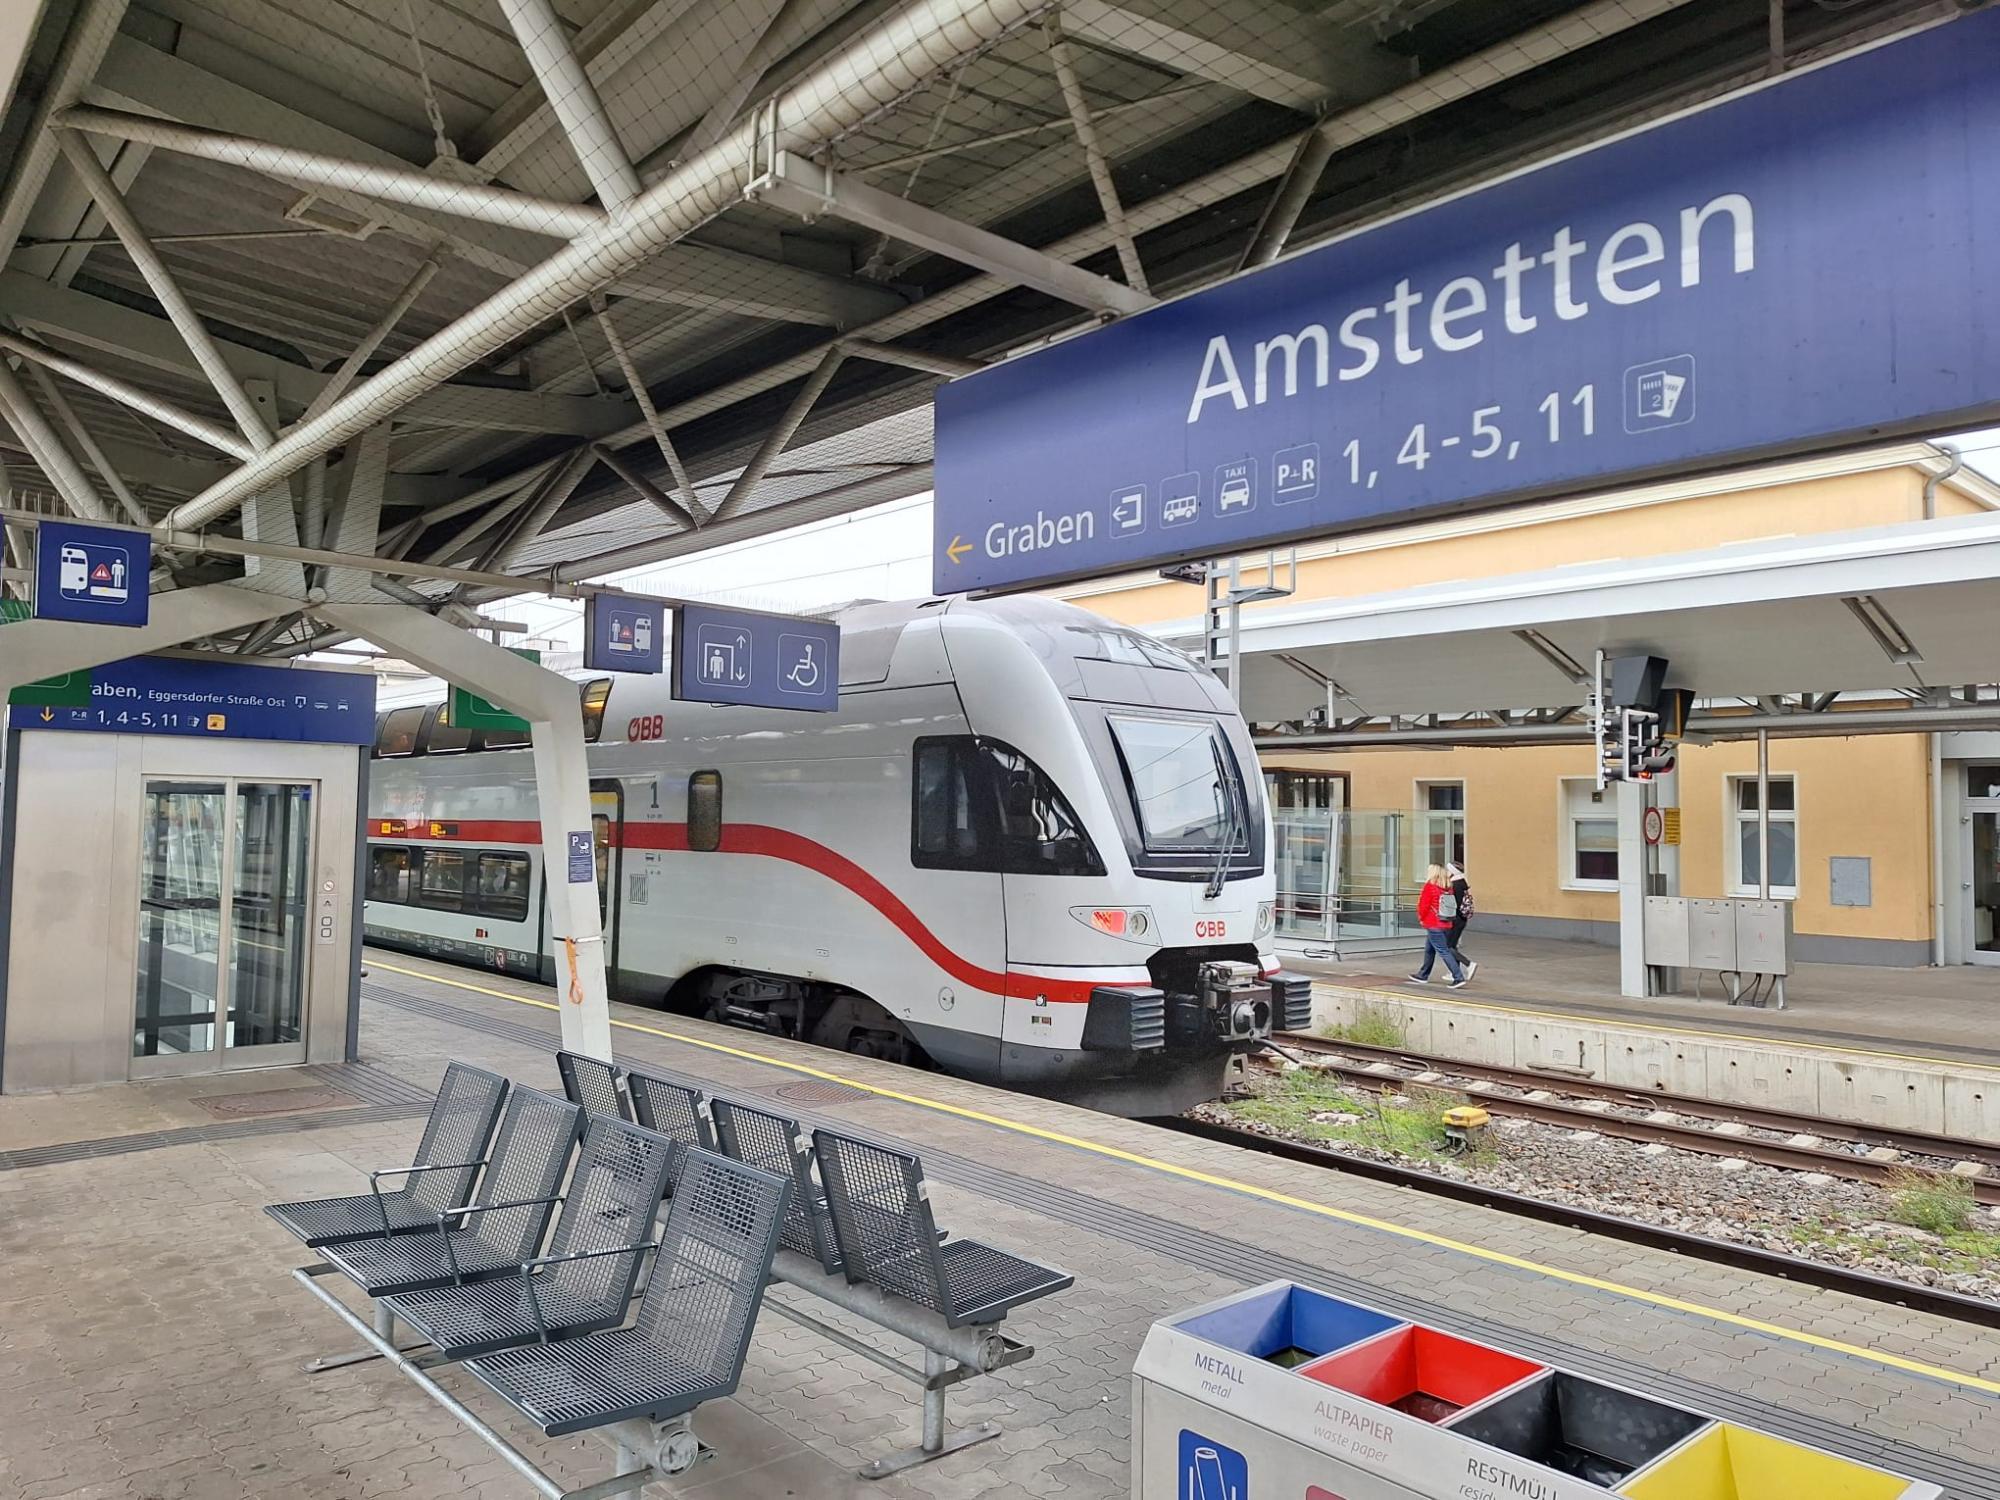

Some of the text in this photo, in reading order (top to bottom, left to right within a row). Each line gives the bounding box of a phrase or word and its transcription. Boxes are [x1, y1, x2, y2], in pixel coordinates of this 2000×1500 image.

[1187, 193, 1754, 424] Amstetten
[985, 510, 1094, 558] Graben
[1224, 465, 1246, 479] TAXI
[1343, 439, 1378, 489] 1,
[1538, 384, 1594, 443] 11
[89, 682, 286, 707] aben, Eggersdorfer Straße Ost
[97, 710, 111, 725] 1,
[162, 713, 177, 727] 11
[650, 781, 659, 809] 1
[572, 835, 579, 847] P
[1195, 1352, 1244, 1385] METALL
[1201, 1380, 1232, 1399] metal
[1314, 1400, 1393, 1444] ALTPAPIER
[1313, 1425, 1389, 1462] waste paper
